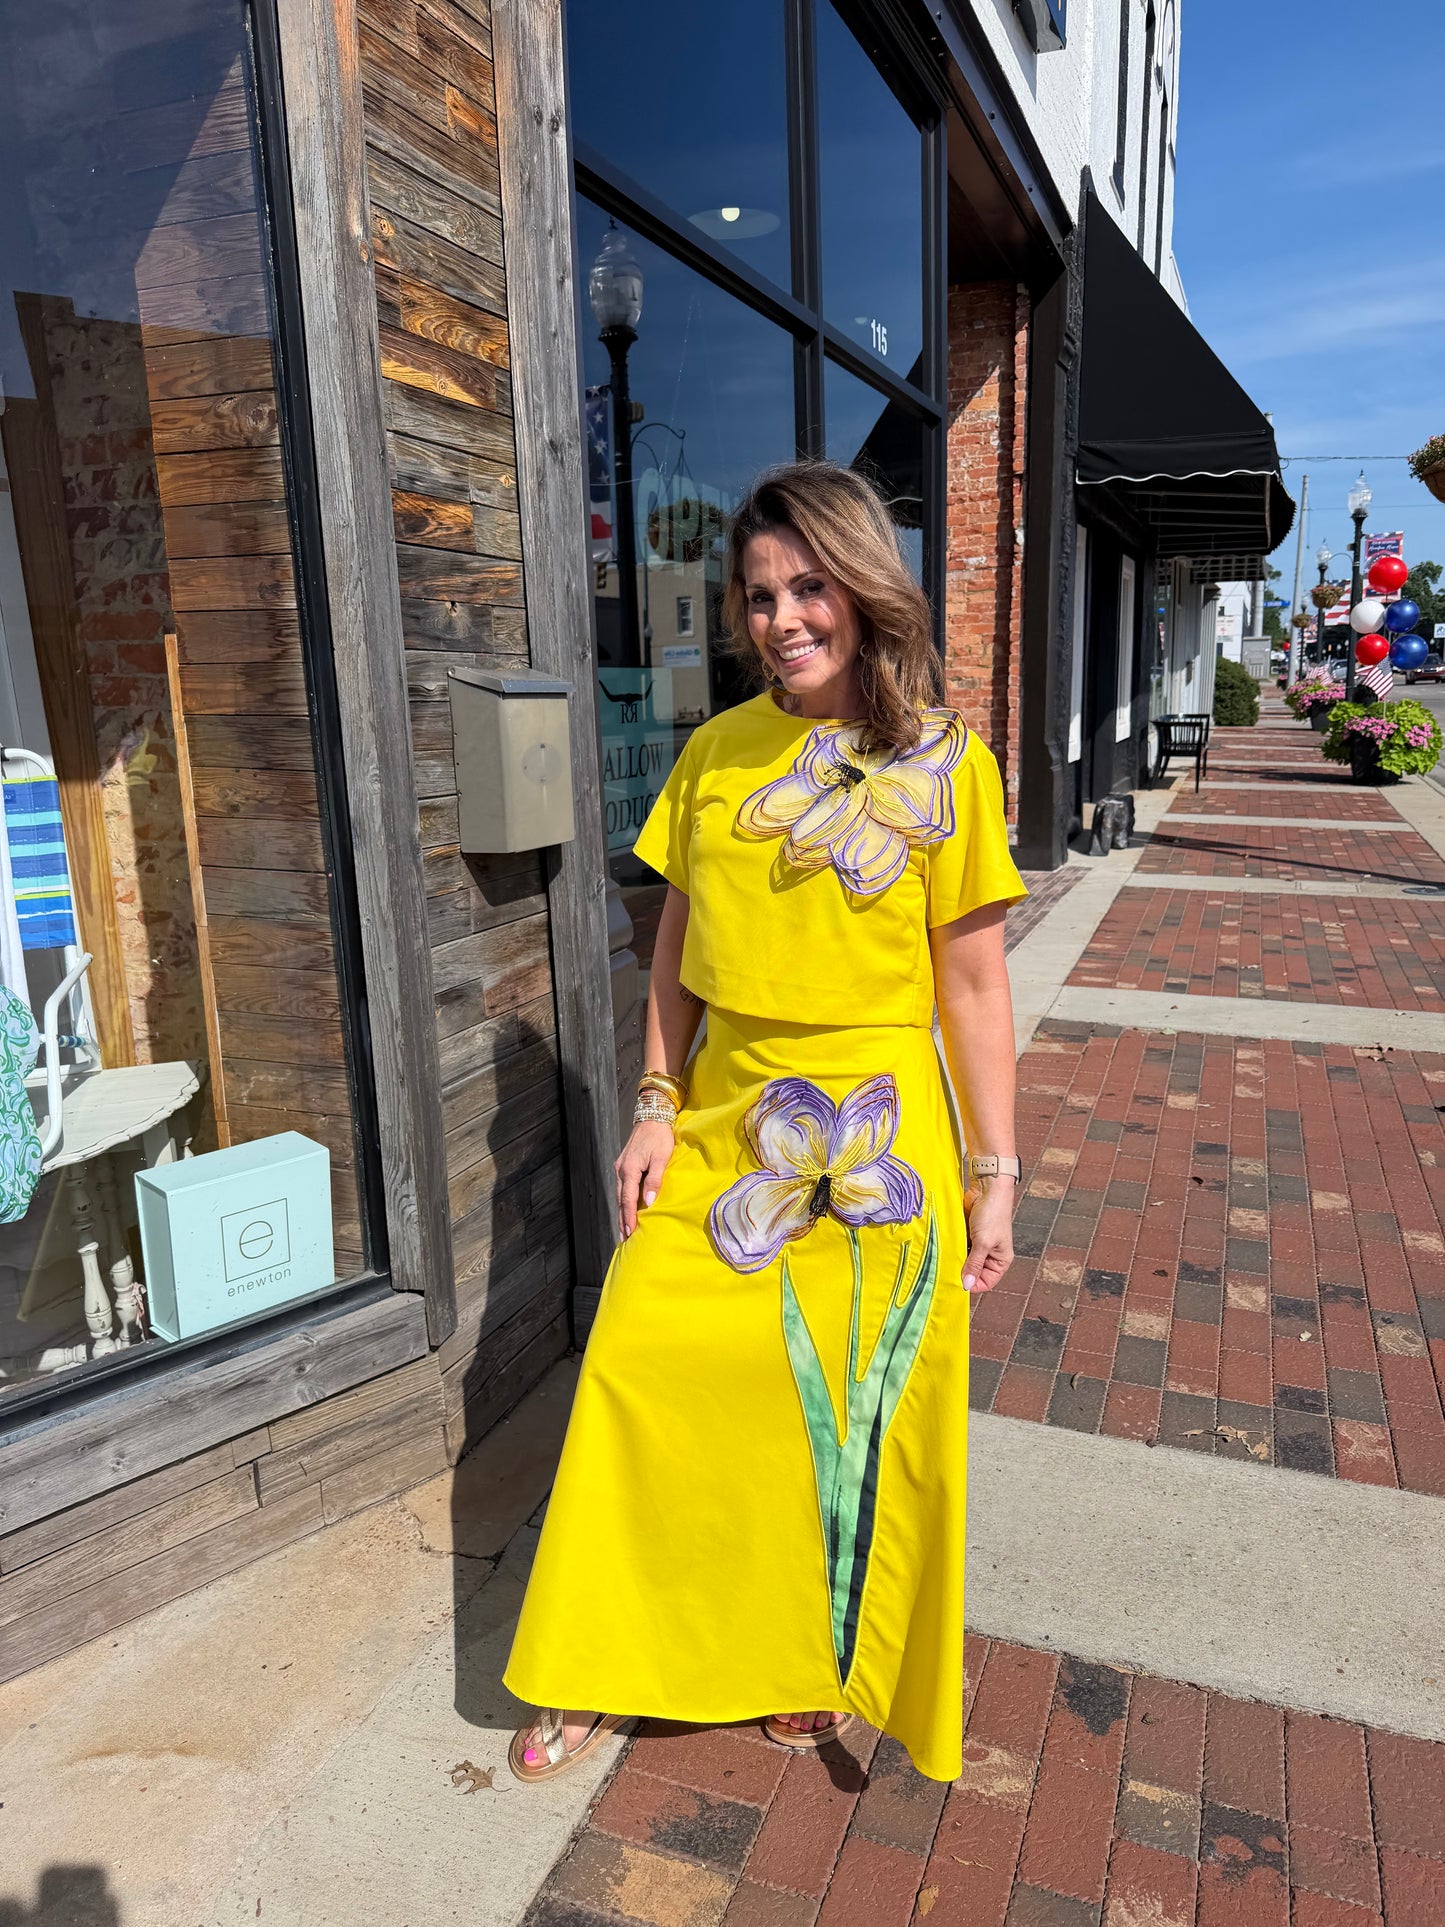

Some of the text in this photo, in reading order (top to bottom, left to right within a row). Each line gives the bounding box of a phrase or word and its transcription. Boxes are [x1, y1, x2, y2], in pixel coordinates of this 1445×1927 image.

[870, 318, 888, 356] 115
[604, 743, 664, 782] ALLOW
[606, 792, 660, 835] ODUC
[240, 1221, 273, 1259] e
[227, 1268, 291, 1297] enewton
